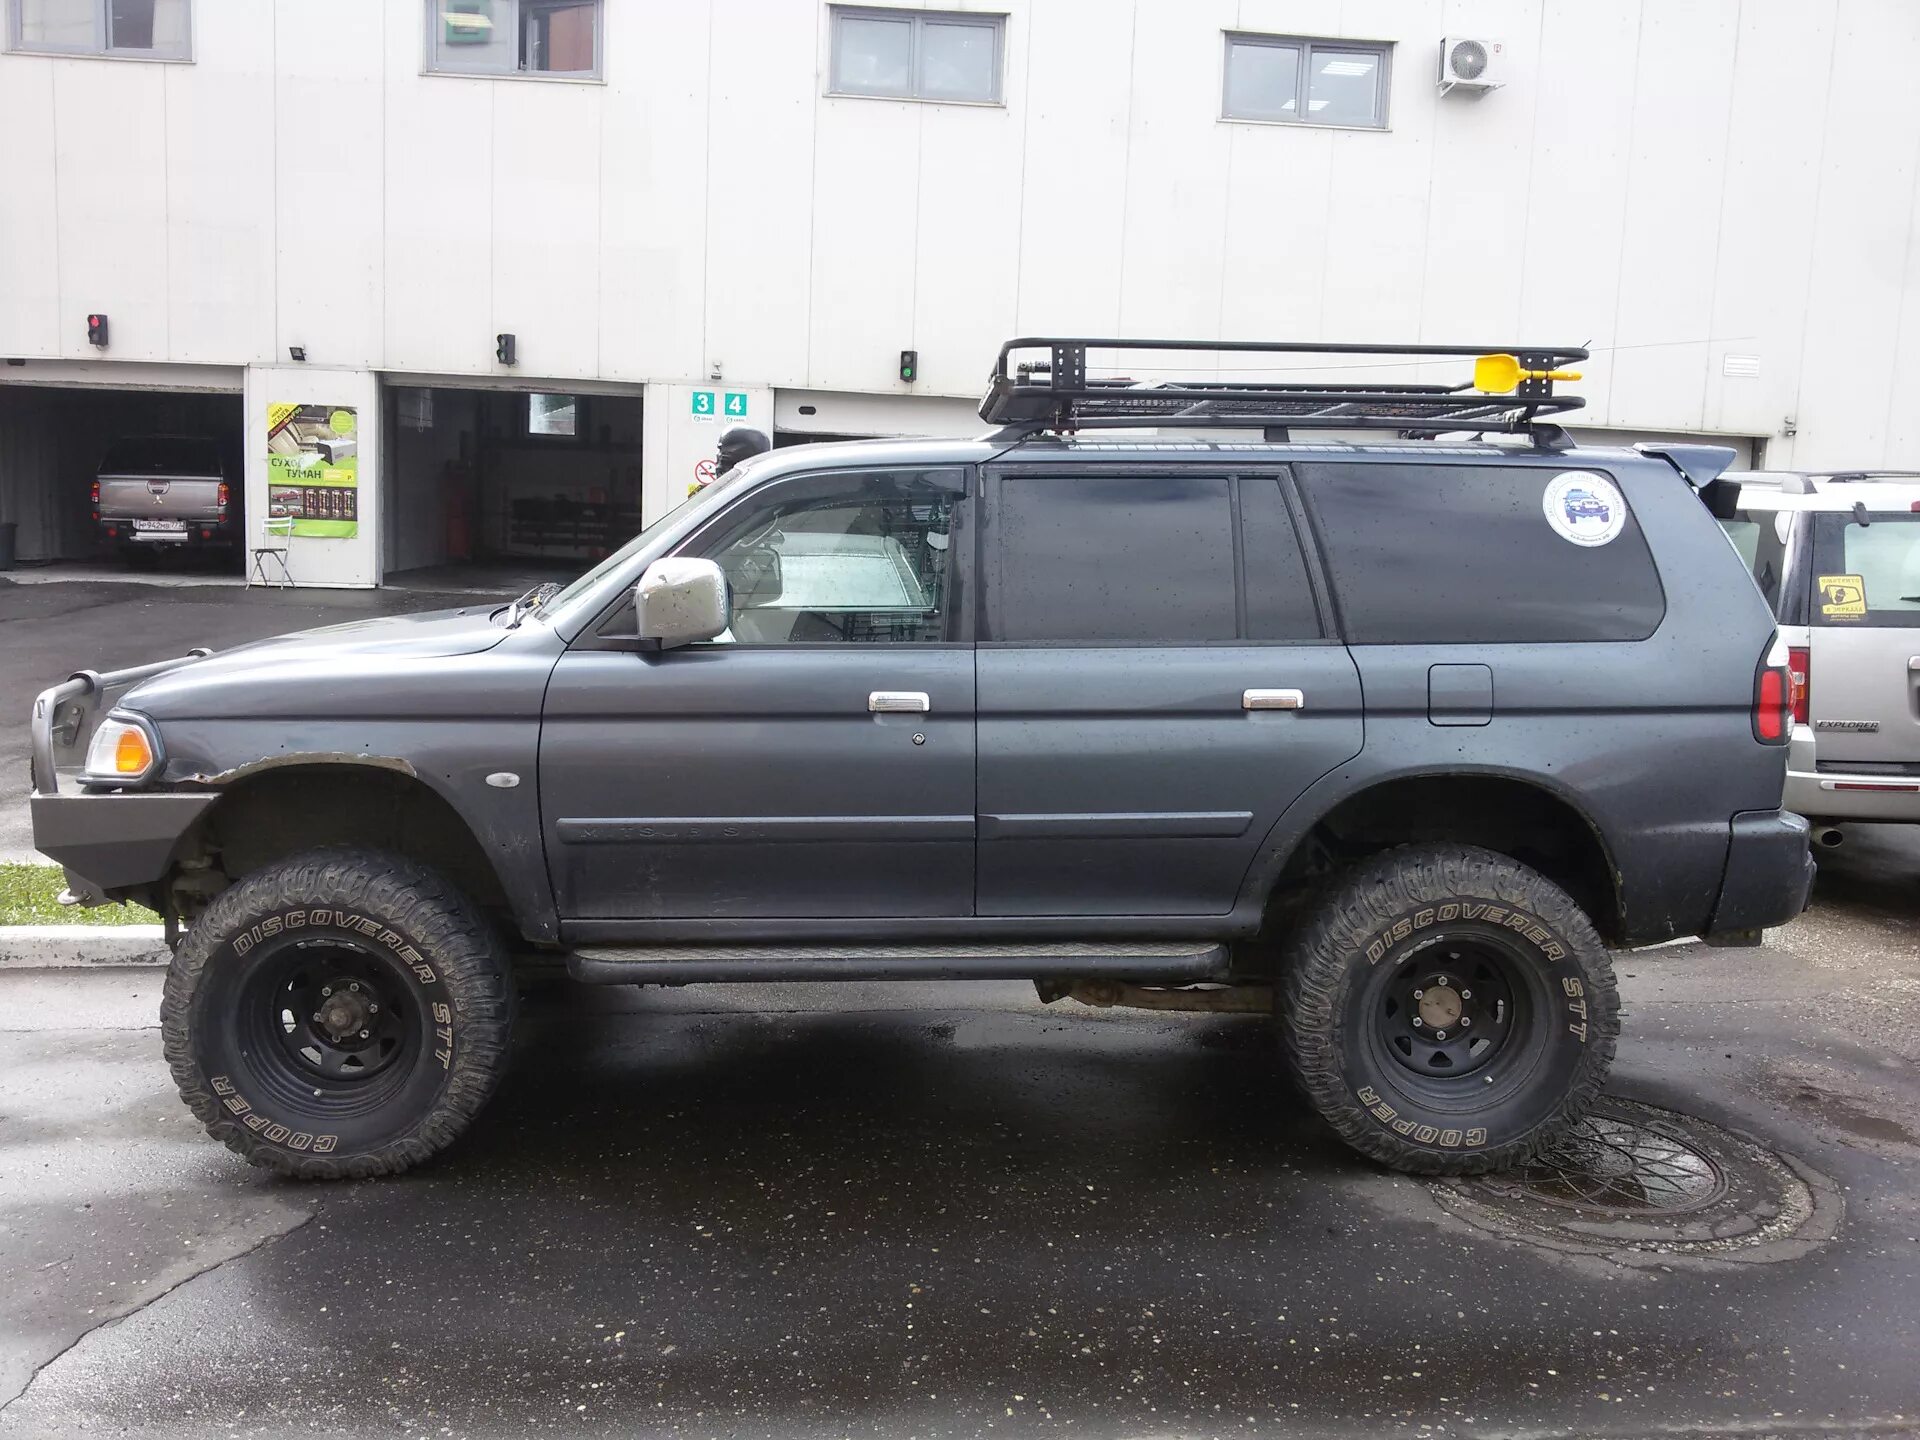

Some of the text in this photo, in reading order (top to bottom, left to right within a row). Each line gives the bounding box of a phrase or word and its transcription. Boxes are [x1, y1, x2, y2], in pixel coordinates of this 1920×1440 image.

[696, 394, 709, 412] 3
[729, 396, 742, 413] 4
[286, 469, 322, 479] ТУМАН
[232, 909, 453, 1070] DISCOVERER STT
[1365, 903, 1587, 1043] DISCOVERER STT
[210, 1075, 338, 1153] COOPER
[1357, 1086, 1487, 1147] COOPER
